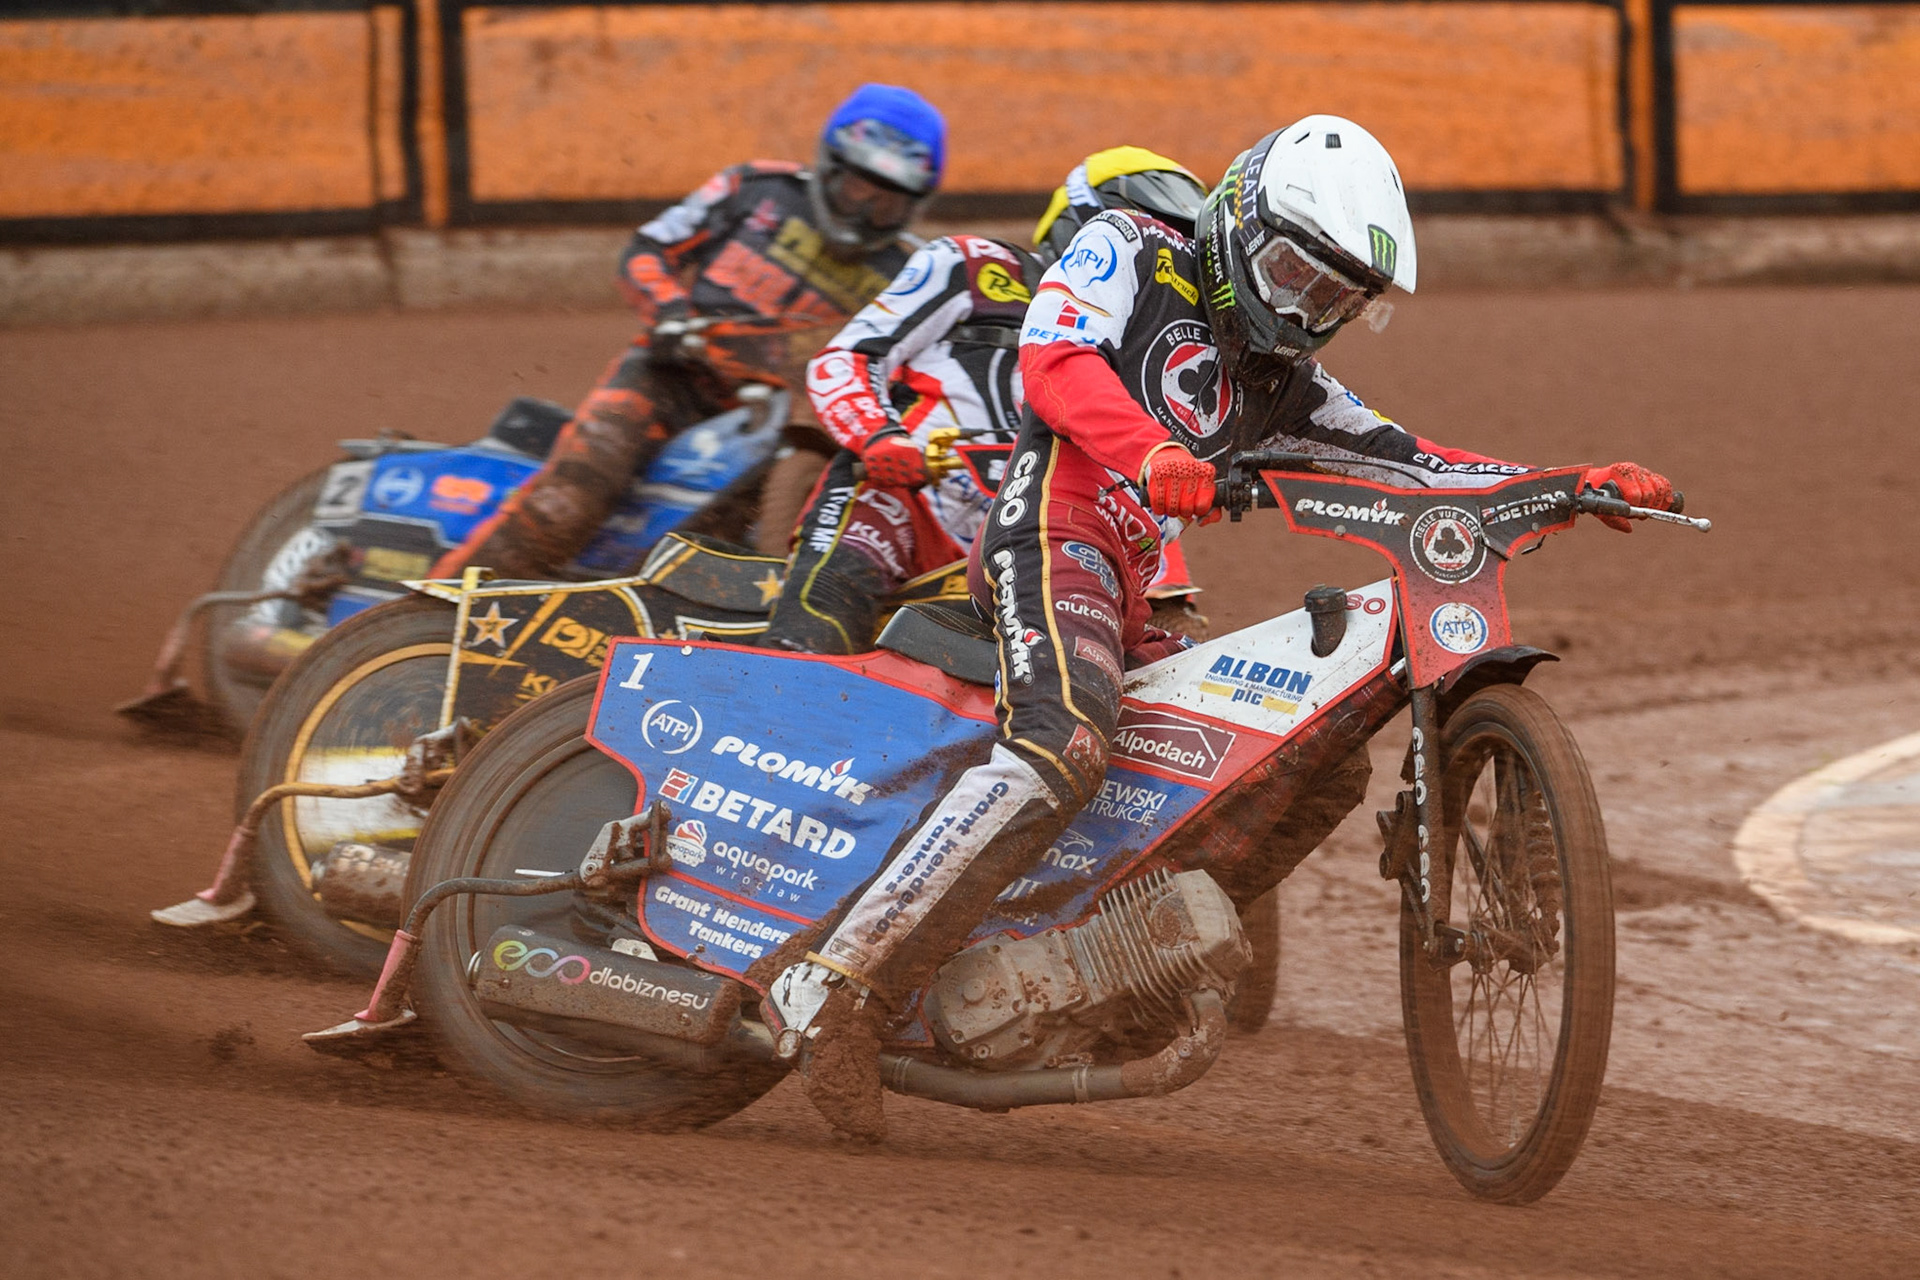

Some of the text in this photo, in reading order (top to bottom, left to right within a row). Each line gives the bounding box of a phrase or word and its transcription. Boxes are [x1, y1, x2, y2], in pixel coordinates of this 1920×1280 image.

[1243, 152, 1265, 221] LEATT
[1211, 211, 1223, 284] MONSTER
[1165, 327, 1201, 346] BELLE
[1438, 510, 1459, 520] VUE
[1461, 515, 1480, 538] ACES
[1346, 593, 1386, 615] SO
[1441, 620, 1477, 635] ATPI
[618, 652, 655, 691] 1
[1204, 673, 1244, 687] ENGINEERING
[1250, 683, 1303, 703] MANUFACTURING
[1209, 654, 1313, 695] ALBON
[1231, 688, 1264, 706] plc
[650, 713, 694, 742] ATPI
[1112, 729, 1208, 770] Alpodach
[691, 781, 857, 860] BETARD
[955, 781, 1010, 837] Grant
[713, 841, 819, 891] aquapark
[885, 814, 957, 894] Tankers
[654, 885, 792, 945] Grant Henders
[689, 919, 764, 959] Tankers
[589, 966, 712, 1010] dlabiznesu
